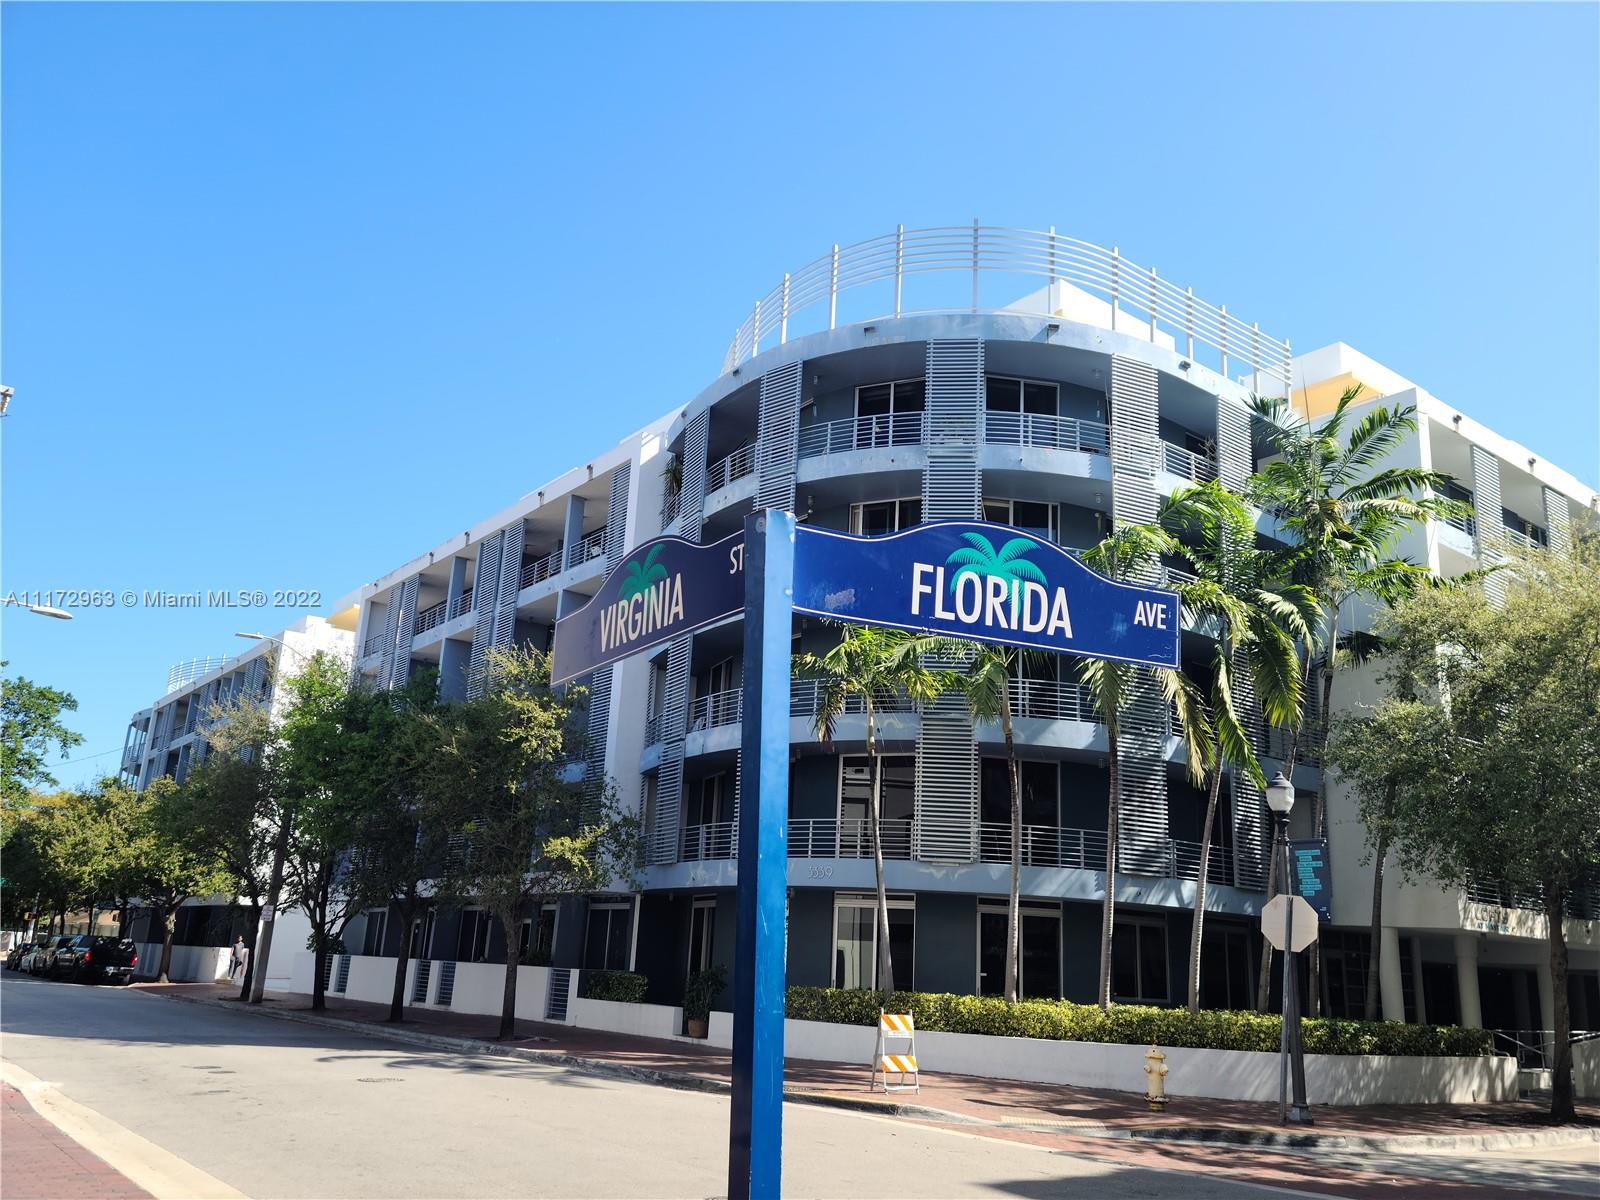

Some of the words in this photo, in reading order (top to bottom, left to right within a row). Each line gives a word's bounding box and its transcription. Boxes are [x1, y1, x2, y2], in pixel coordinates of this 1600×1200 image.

[601, 573, 684, 652] VIRGINIA
[729, 543, 744, 575] ST
[911, 562, 1073, 639] FLORIDA
[1133, 601, 1167, 630] AVE
